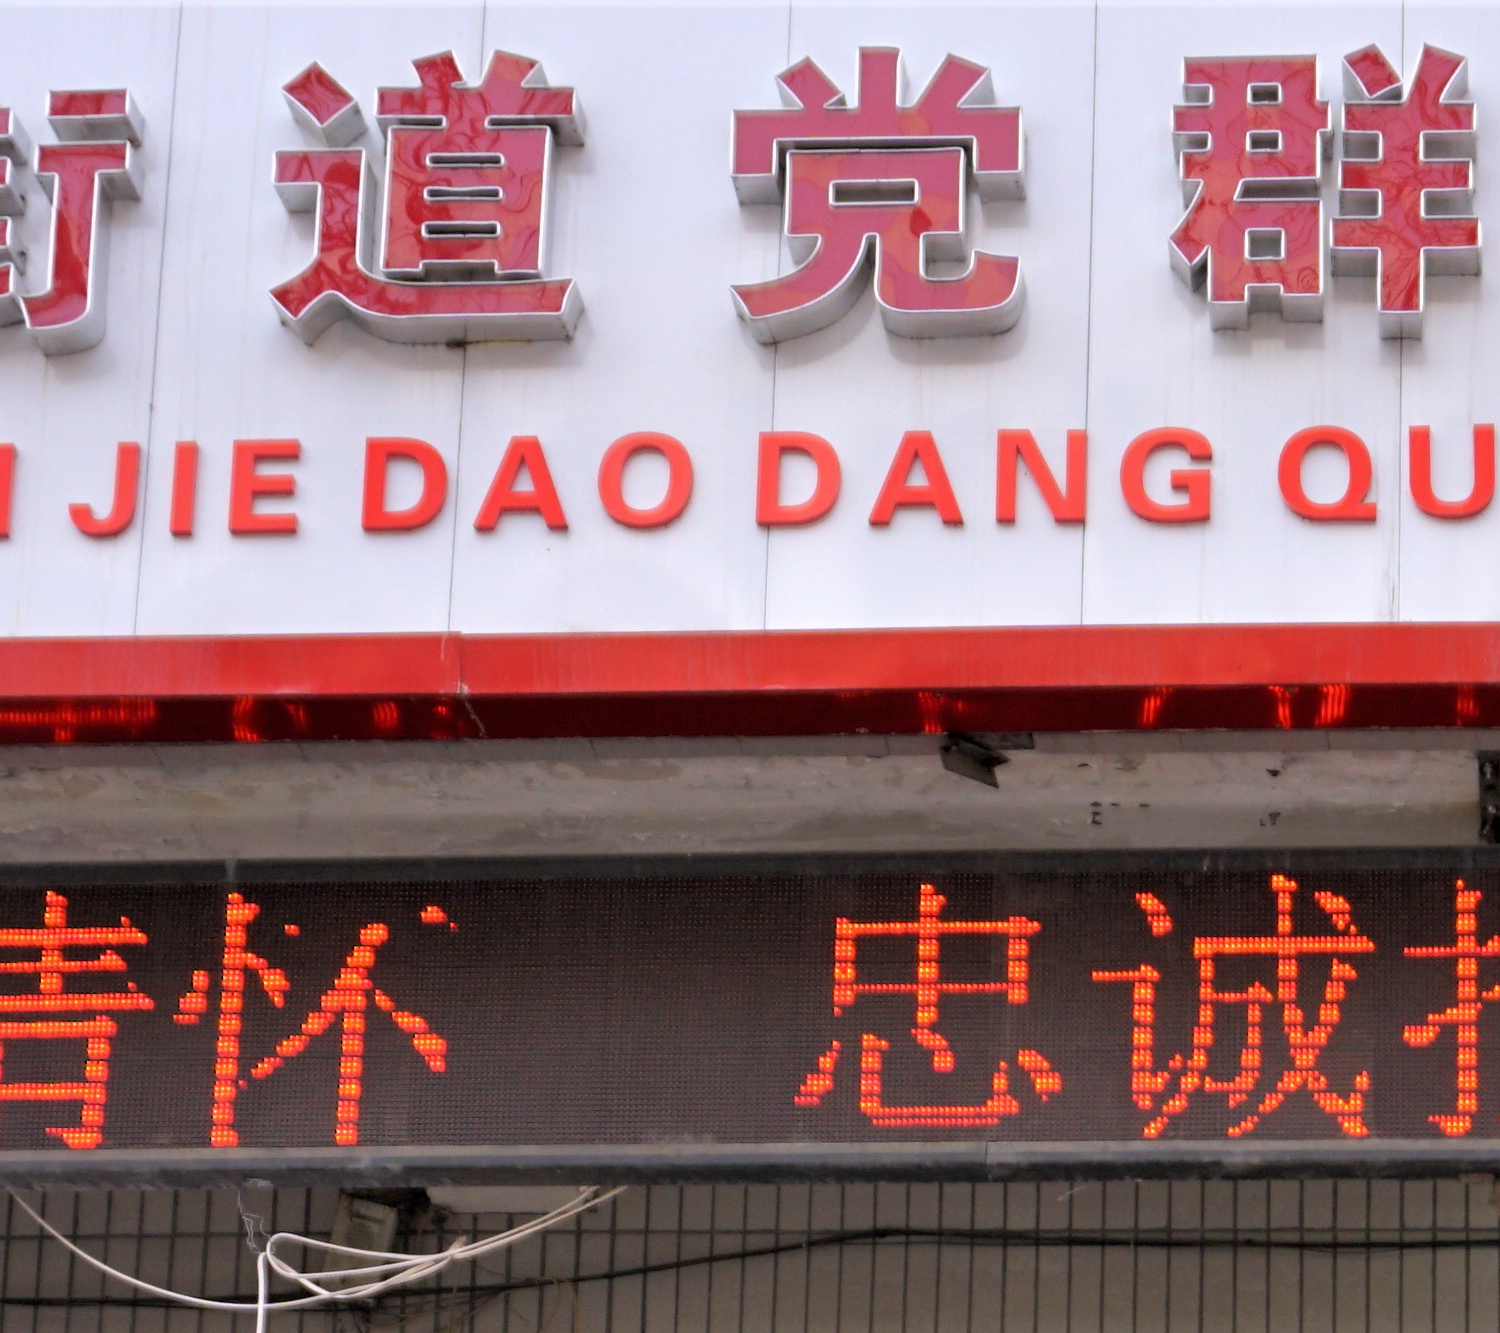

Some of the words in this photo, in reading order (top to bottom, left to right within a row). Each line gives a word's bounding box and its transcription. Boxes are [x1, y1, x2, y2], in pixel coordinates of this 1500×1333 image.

[70, 441, 300, 539] JIE
[362, 434, 693, 533] DAO
[757, 429, 1213, 529] DANG
